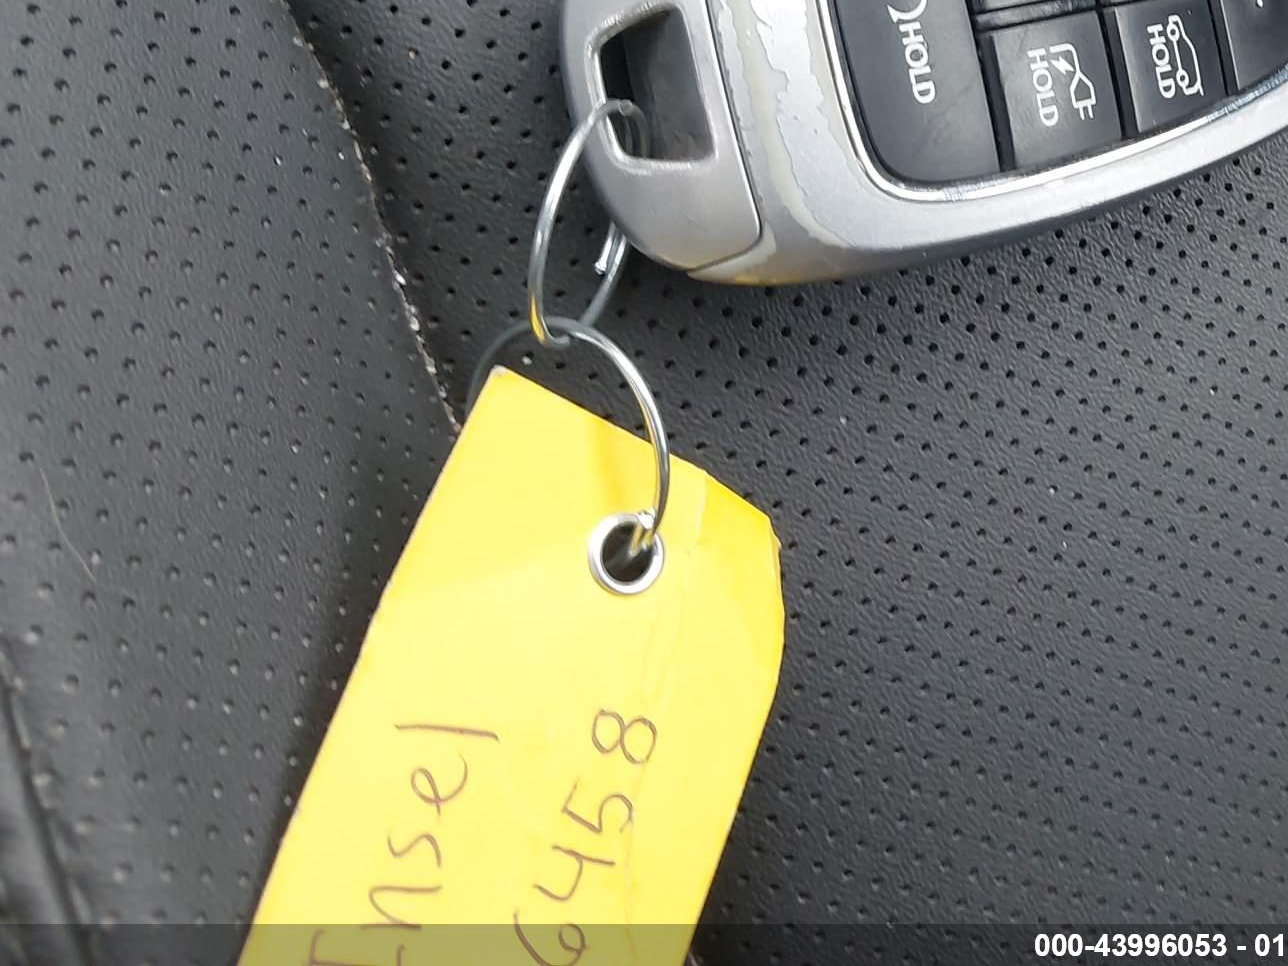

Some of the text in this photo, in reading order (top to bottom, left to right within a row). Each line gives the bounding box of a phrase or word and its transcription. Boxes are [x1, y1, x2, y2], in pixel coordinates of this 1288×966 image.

[900, 20, 937, 105] HOLD
[1027, 46, 1060, 128] HOLD
[1146, 23, 1177, 100] HOLD
[513, 708, 658, 966] 6458
